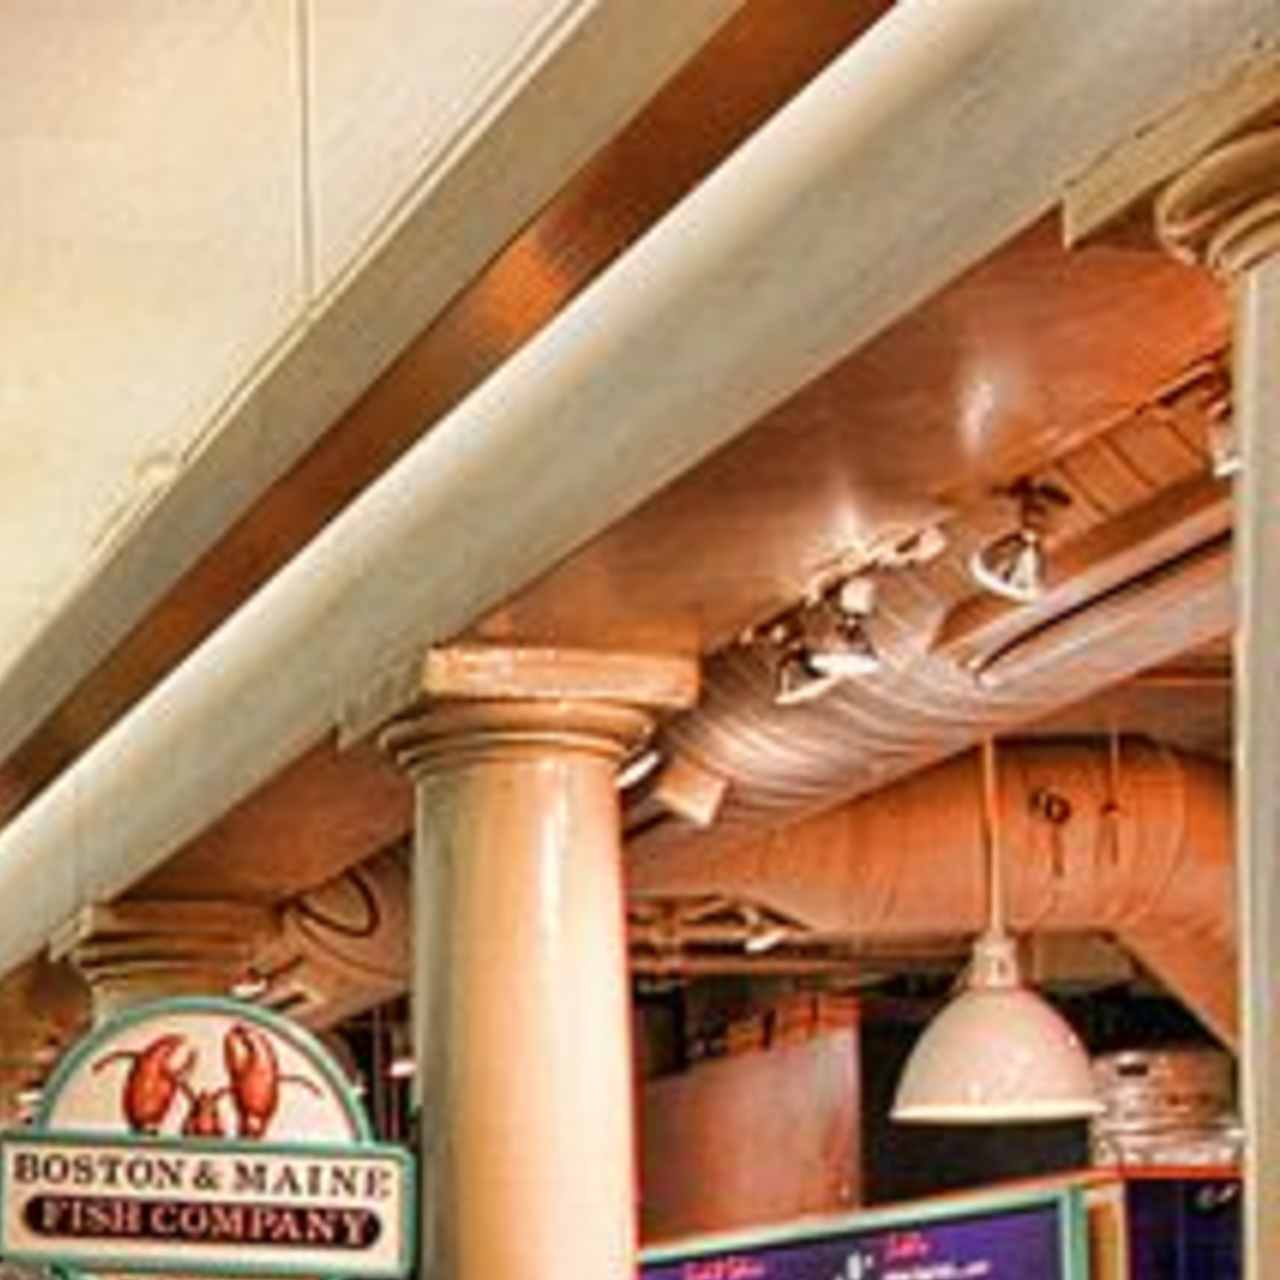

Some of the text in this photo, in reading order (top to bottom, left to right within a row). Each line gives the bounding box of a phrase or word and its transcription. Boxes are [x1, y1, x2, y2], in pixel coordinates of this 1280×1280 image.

[12, 1153, 392, 1199] BOSTON & MAINE
[40, 1200, 370, 1246] FISH COMPANY
